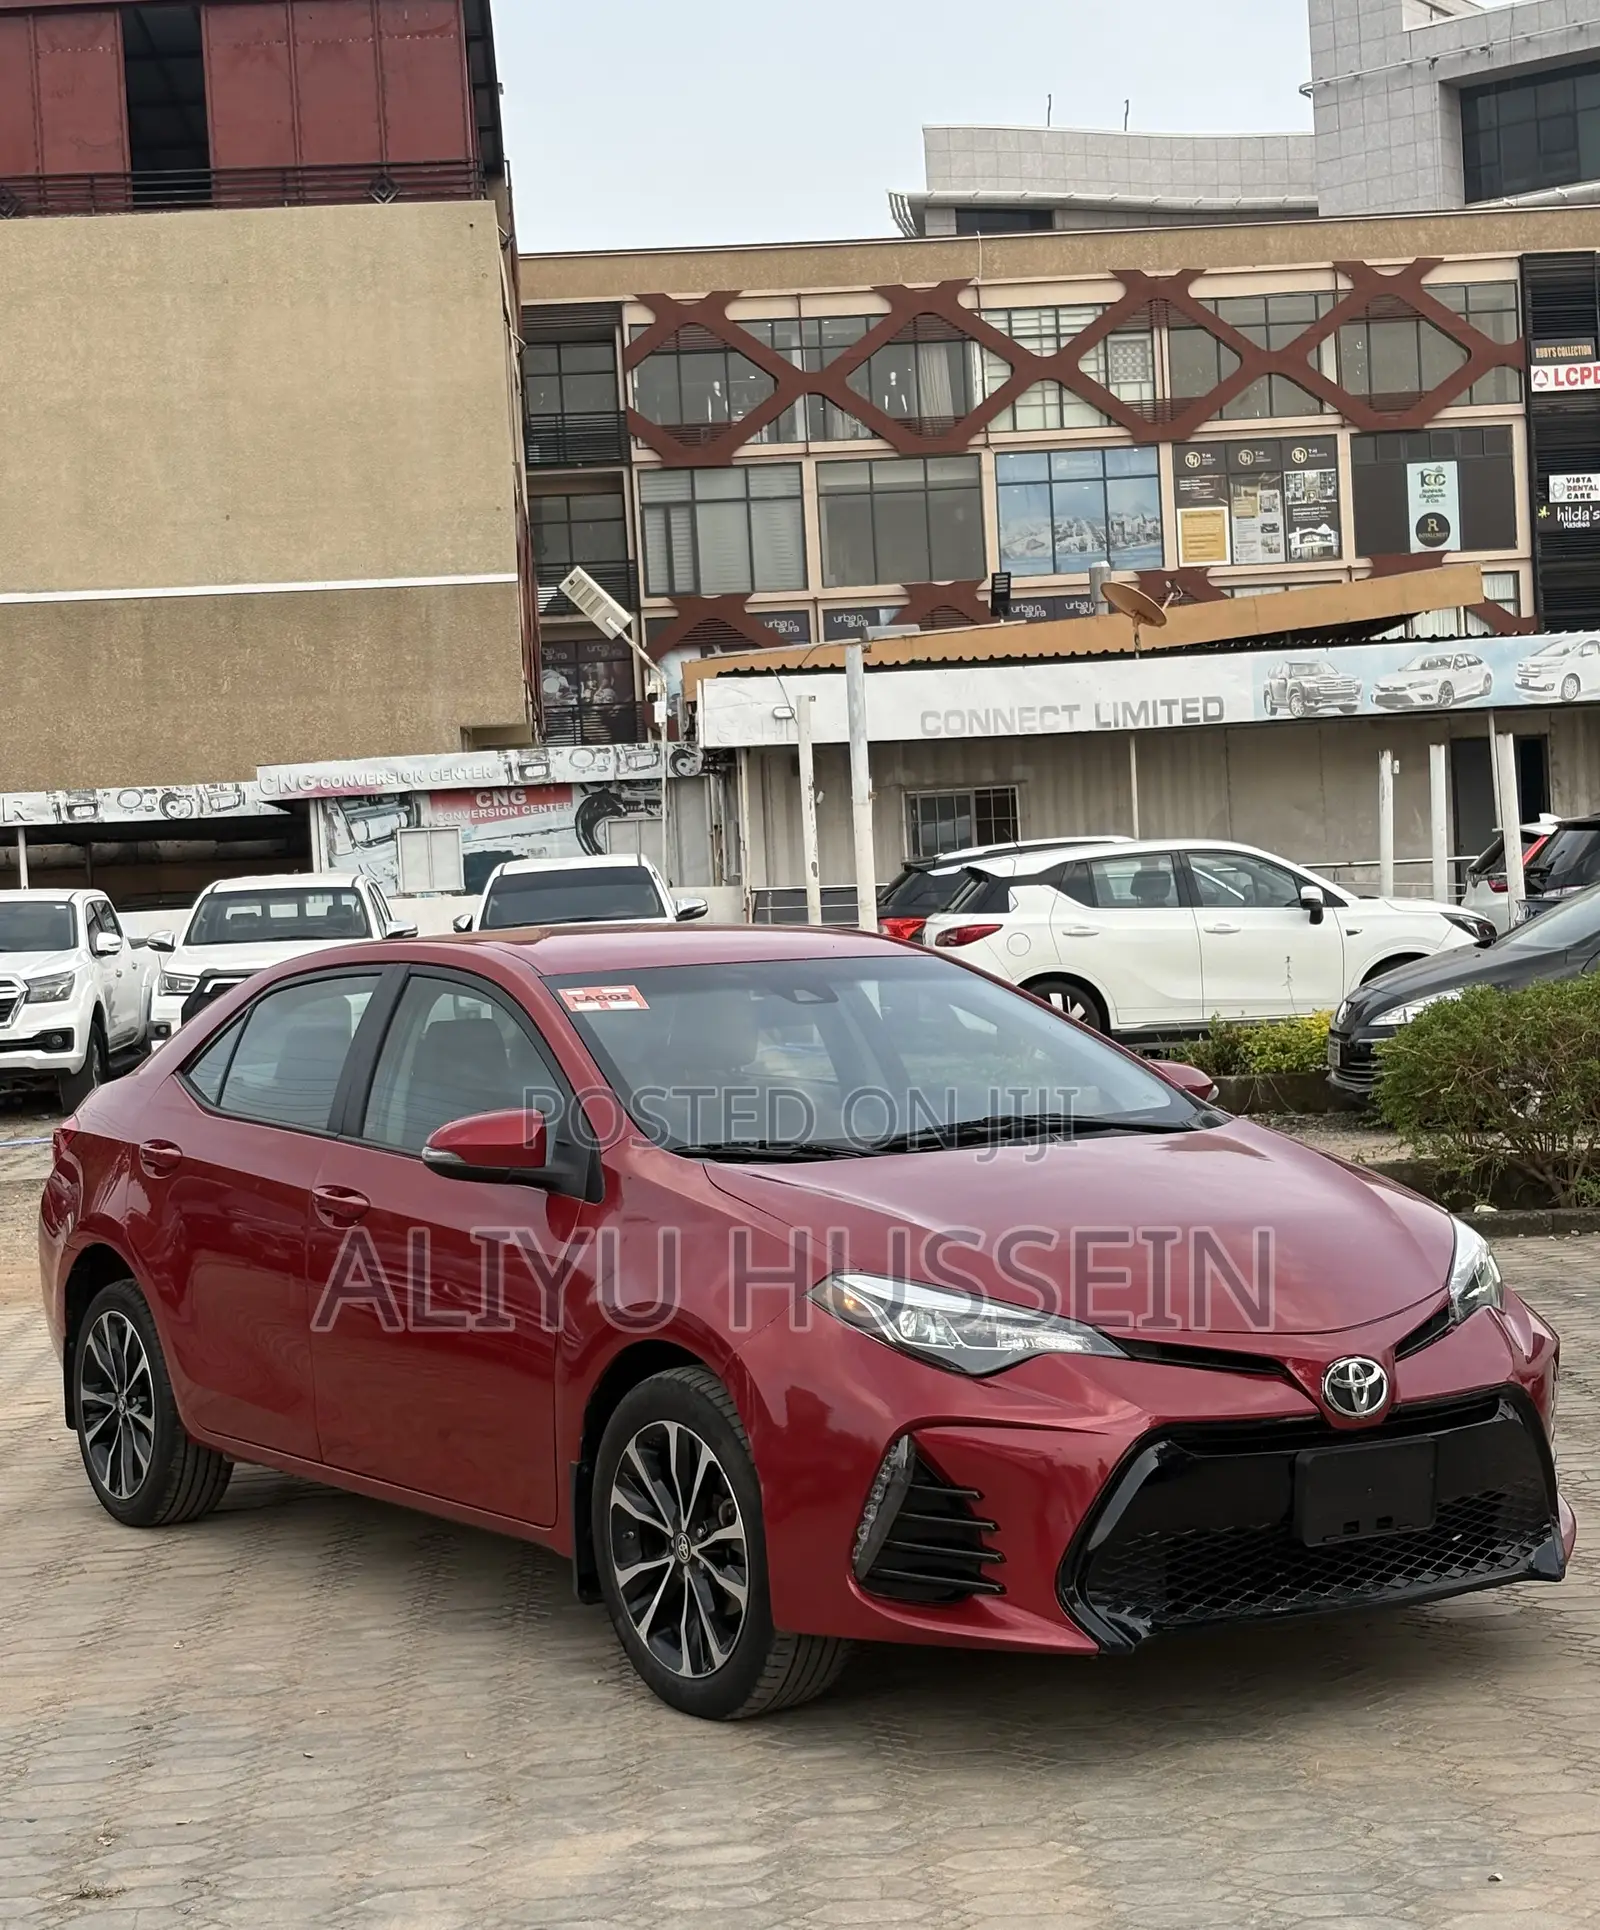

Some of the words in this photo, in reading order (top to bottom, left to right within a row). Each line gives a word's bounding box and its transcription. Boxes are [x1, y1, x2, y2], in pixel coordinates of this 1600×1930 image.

[1557, 345, 1592, 357] COLLECTION
[1566, 484, 1599, 492] DENTAL
[1557, 505, 1600, 521] hilda's
[1427, 518, 1439, 532] R
[1010, 604, 1042, 613] urban
[1024, 609, 1046, 618] aura
[1079, 607, 1095, 615] aur
[764, 619, 795, 629] urban
[833, 614, 864, 624] urban
[847, 618, 869, 628] aura
[778, 624, 800, 634] aura
[920, 704, 1081, 737] CONNECT
[1094, 696, 1225, 728] LIMITED
[259, 773, 318, 795] CNG
[319, 770, 425, 789] CONVERSION
[429, 766, 493, 782] CENTER
[475, 789, 528, 807] CNG
[436, 806, 518, 822] CONVERSION
[522, 802, 573, 815] CENTER
[572, 994, 633, 1003] LAGOS
